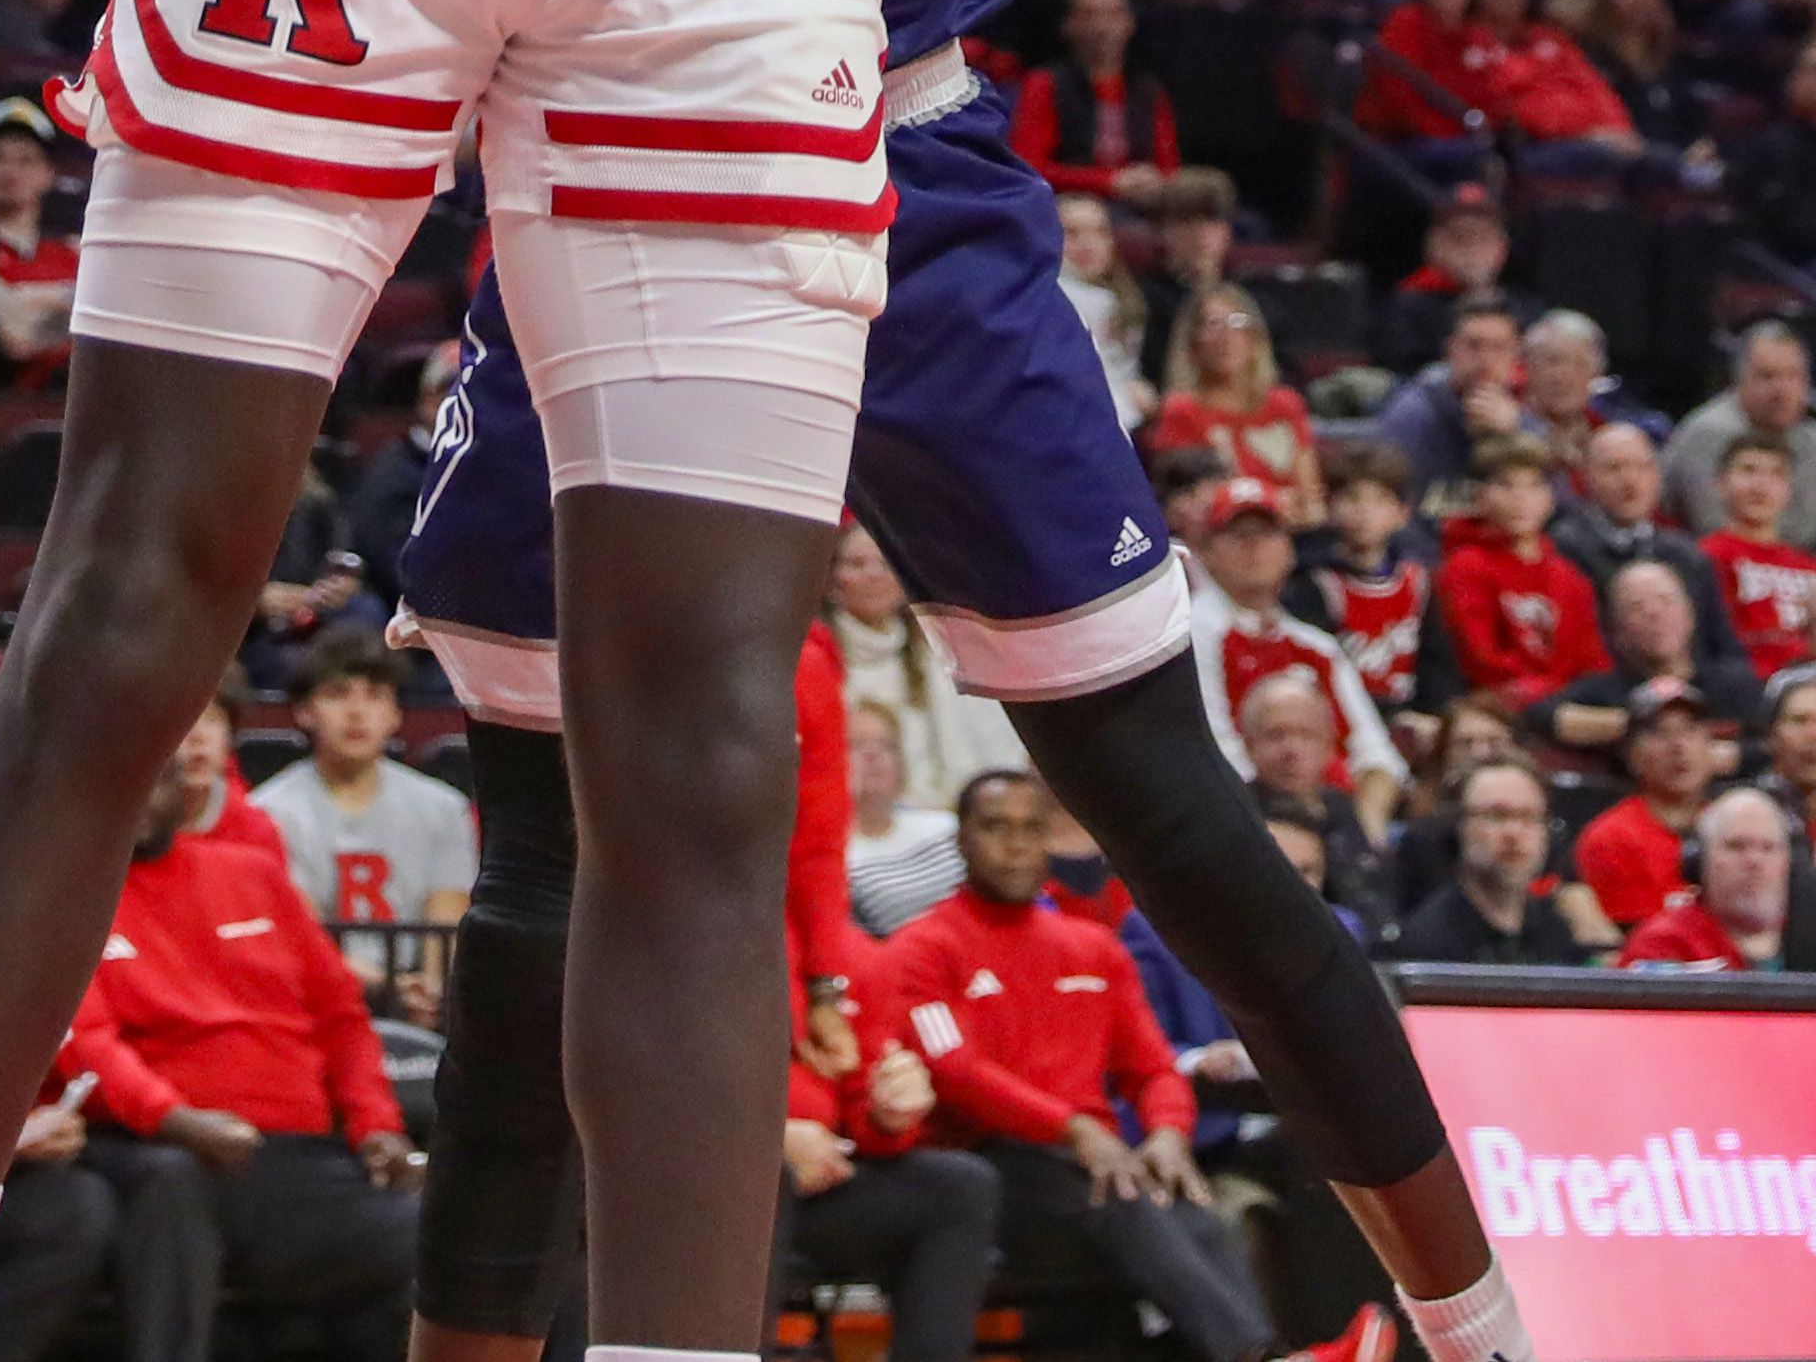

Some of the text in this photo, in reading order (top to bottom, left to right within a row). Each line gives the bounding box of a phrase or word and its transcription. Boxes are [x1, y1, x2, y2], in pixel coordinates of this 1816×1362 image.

[811, 85, 865, 110] adidas
[1110, 537, 1152, 566] adidas
[334, 852, 398, 925] R
